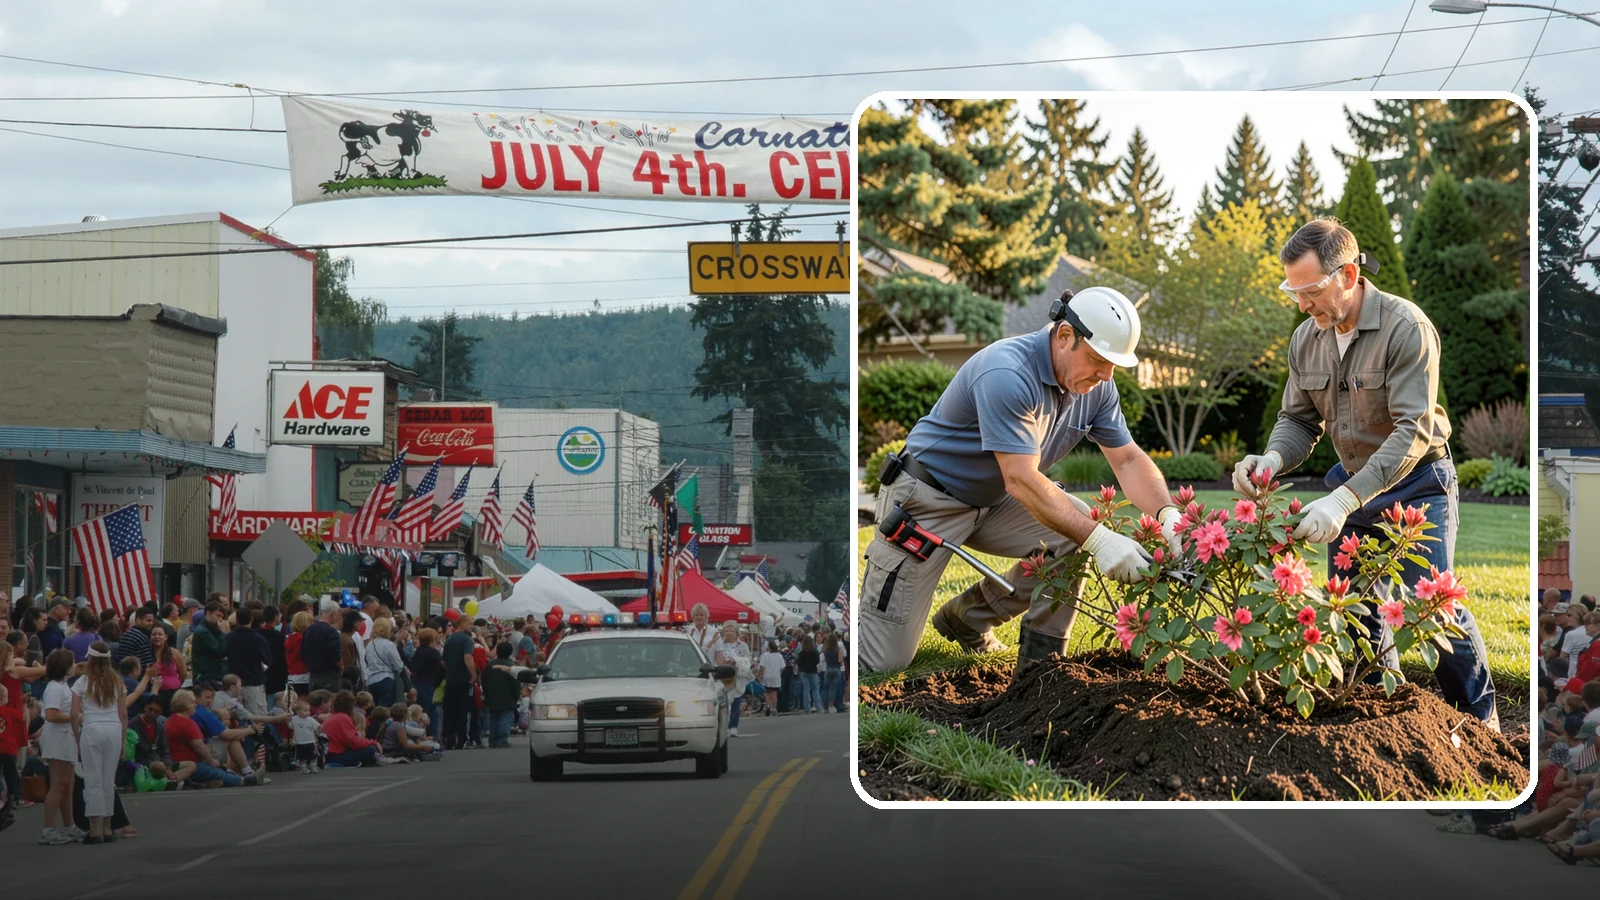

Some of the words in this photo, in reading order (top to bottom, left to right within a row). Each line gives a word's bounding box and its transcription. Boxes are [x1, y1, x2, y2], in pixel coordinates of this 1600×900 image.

[695, 121, 850, 150] Carnat
[481, 141, 605, 192] JULY
[632, 150, 746, 198] 4th.
[696, 254, 850, 280] CROSSWA
[282, 380, 374, 420] ACE
[405, 409, 453, 422] CEDAR
[461, 409, 486, 422] LOG
[283, 421, 371, 436] Hardware
[416, 428, 477, 447] Coca-Cola
[353, 467, 384, 479] Simpl
[95, 485, 124, 495] Vincent
[126, 485, 136, 495] de
[137, 485, 155, 495] Paul
[688, 526, 741, 535] CRNATION
[699, 535, 730, 544] GLASS
